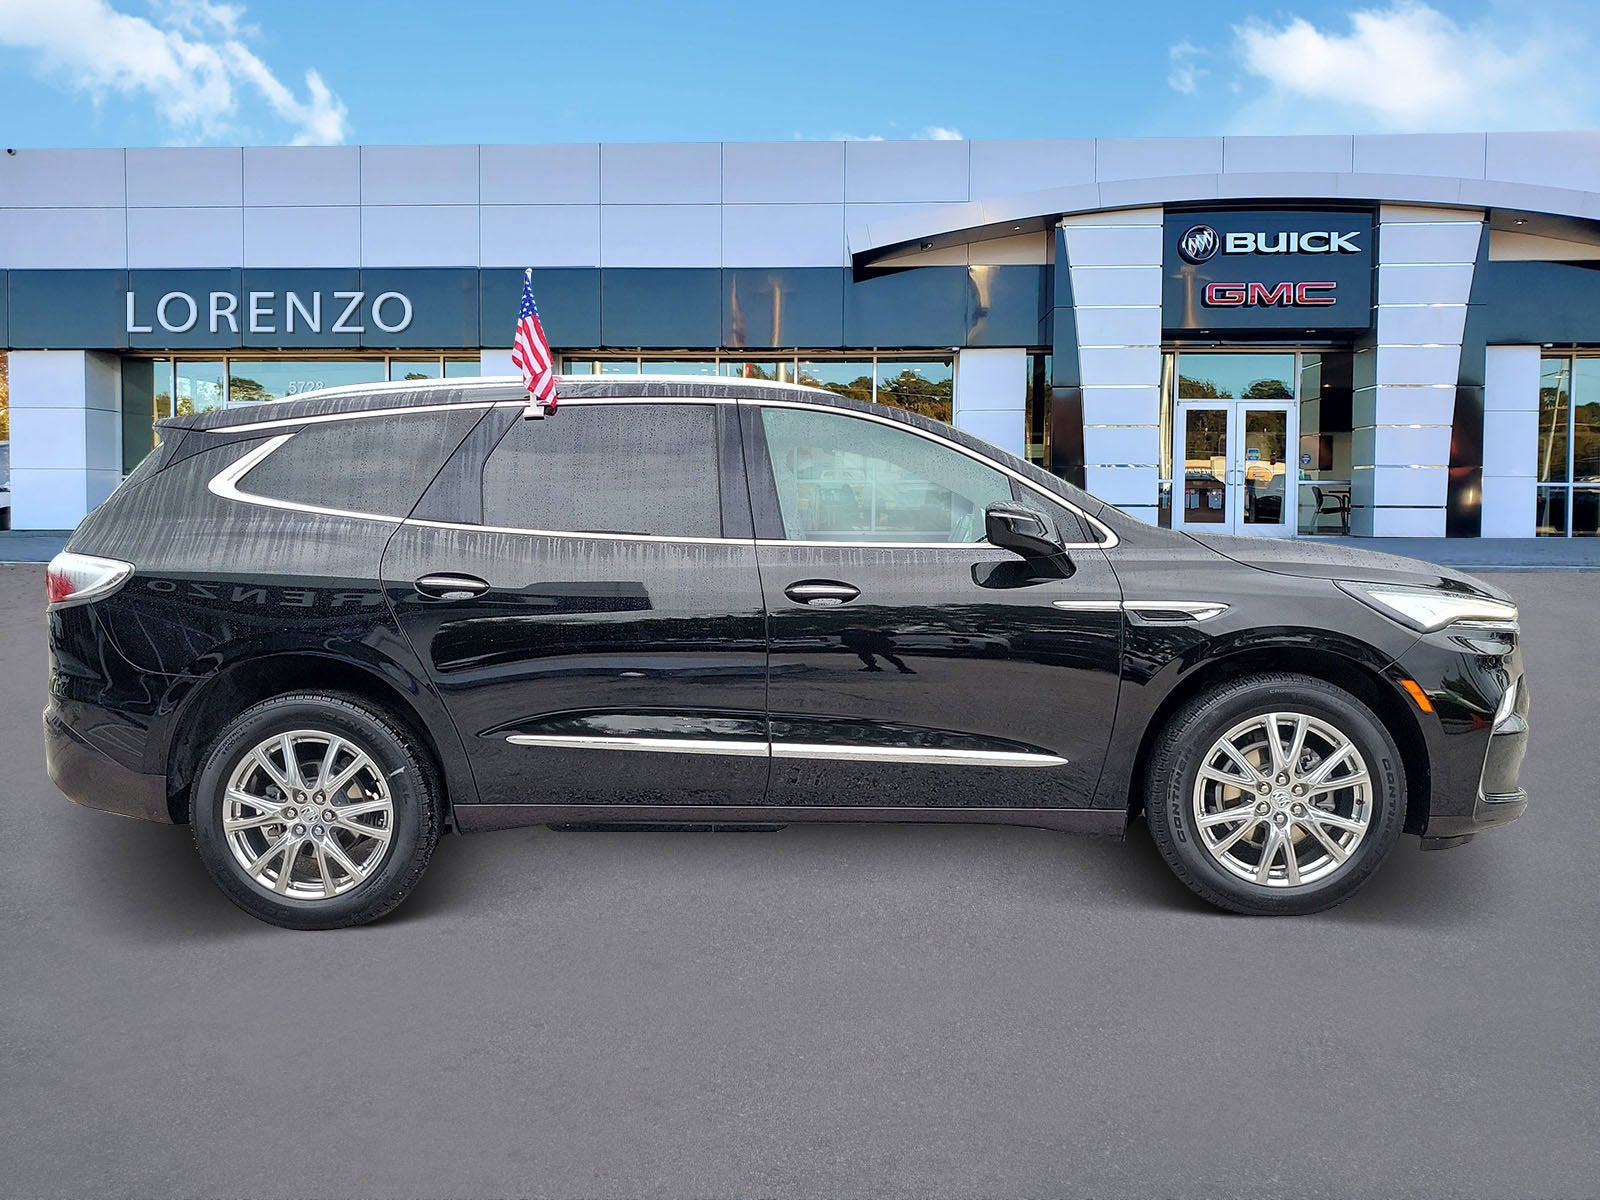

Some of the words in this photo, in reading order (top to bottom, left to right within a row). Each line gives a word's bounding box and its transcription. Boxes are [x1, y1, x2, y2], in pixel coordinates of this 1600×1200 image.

[1225, 231, 1362, 254] BUICK
[1205, 281, 1337, 306] GMC
[126, 291, 414, 333] LORENZO
